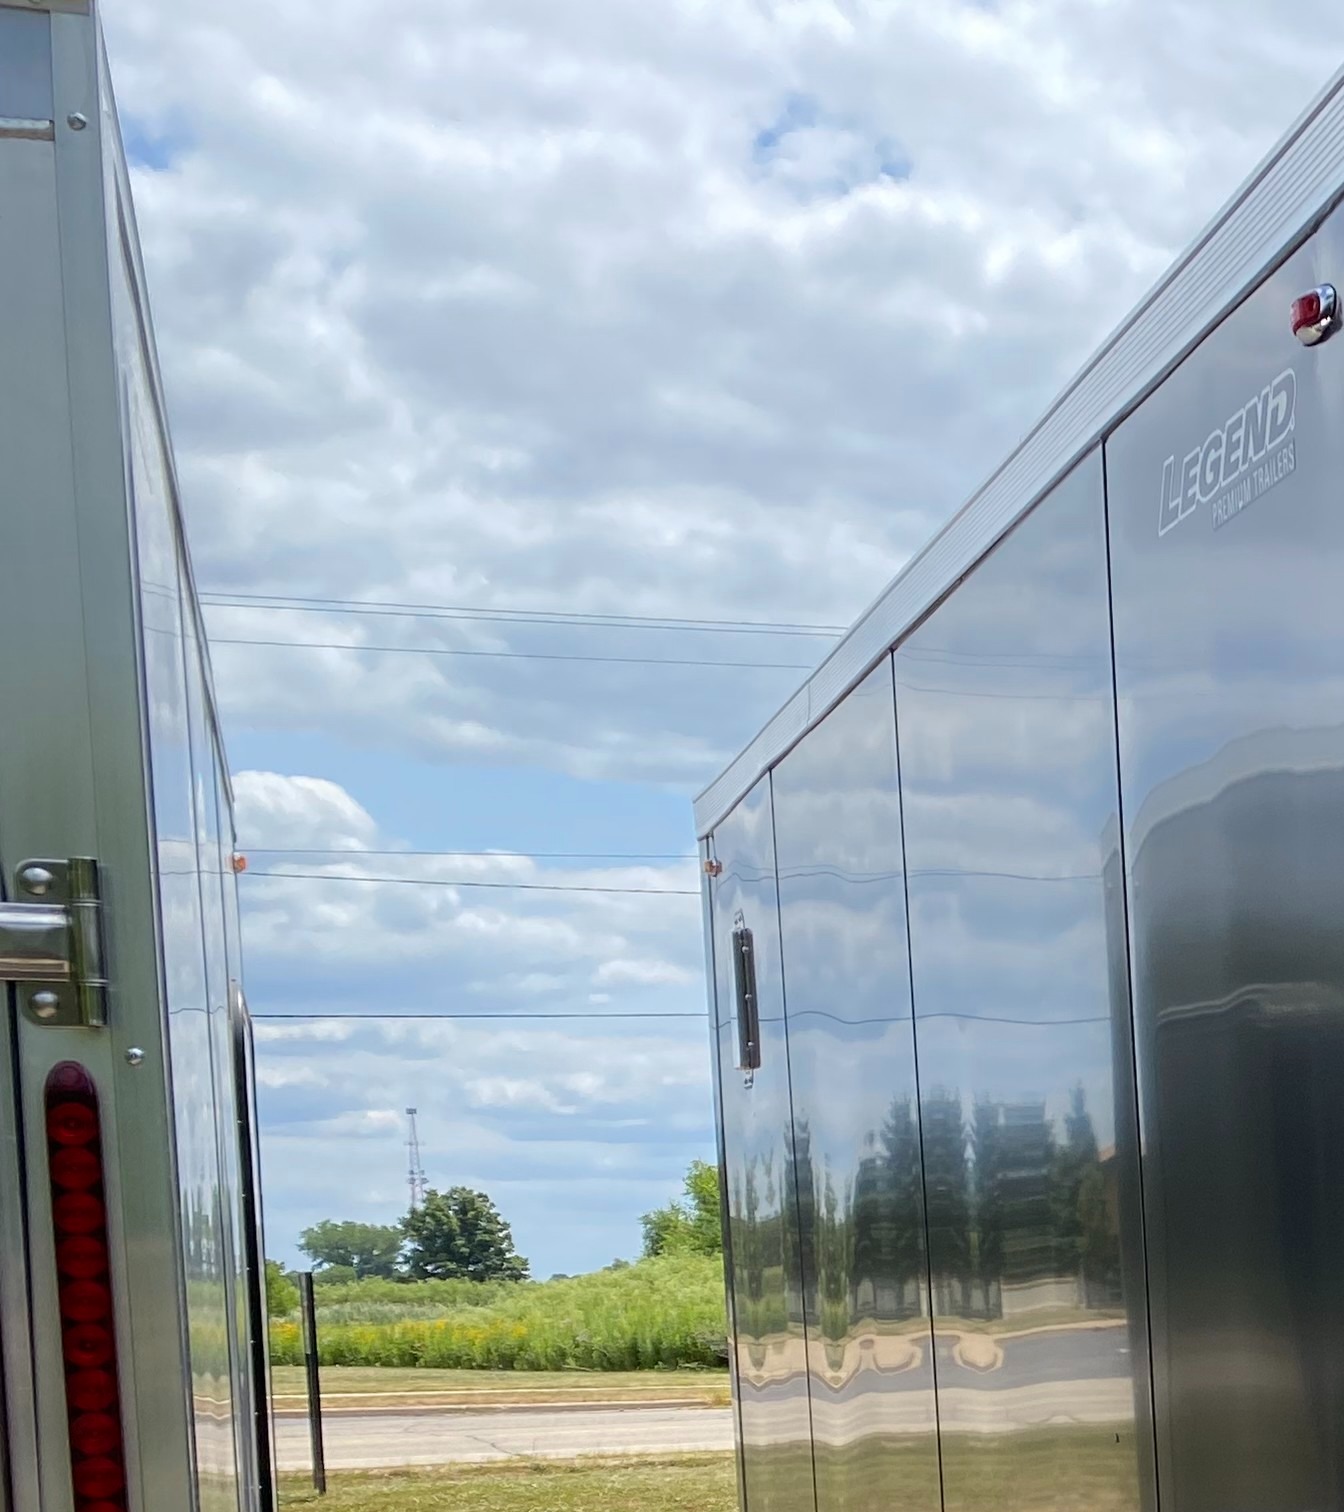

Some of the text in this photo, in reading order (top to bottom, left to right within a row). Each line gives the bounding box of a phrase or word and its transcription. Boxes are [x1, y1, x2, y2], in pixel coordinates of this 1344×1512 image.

[1158, 368, 1297, 537] LEGEND
[1212, 443, 1295, 527] PREMIUM TRAILERS
